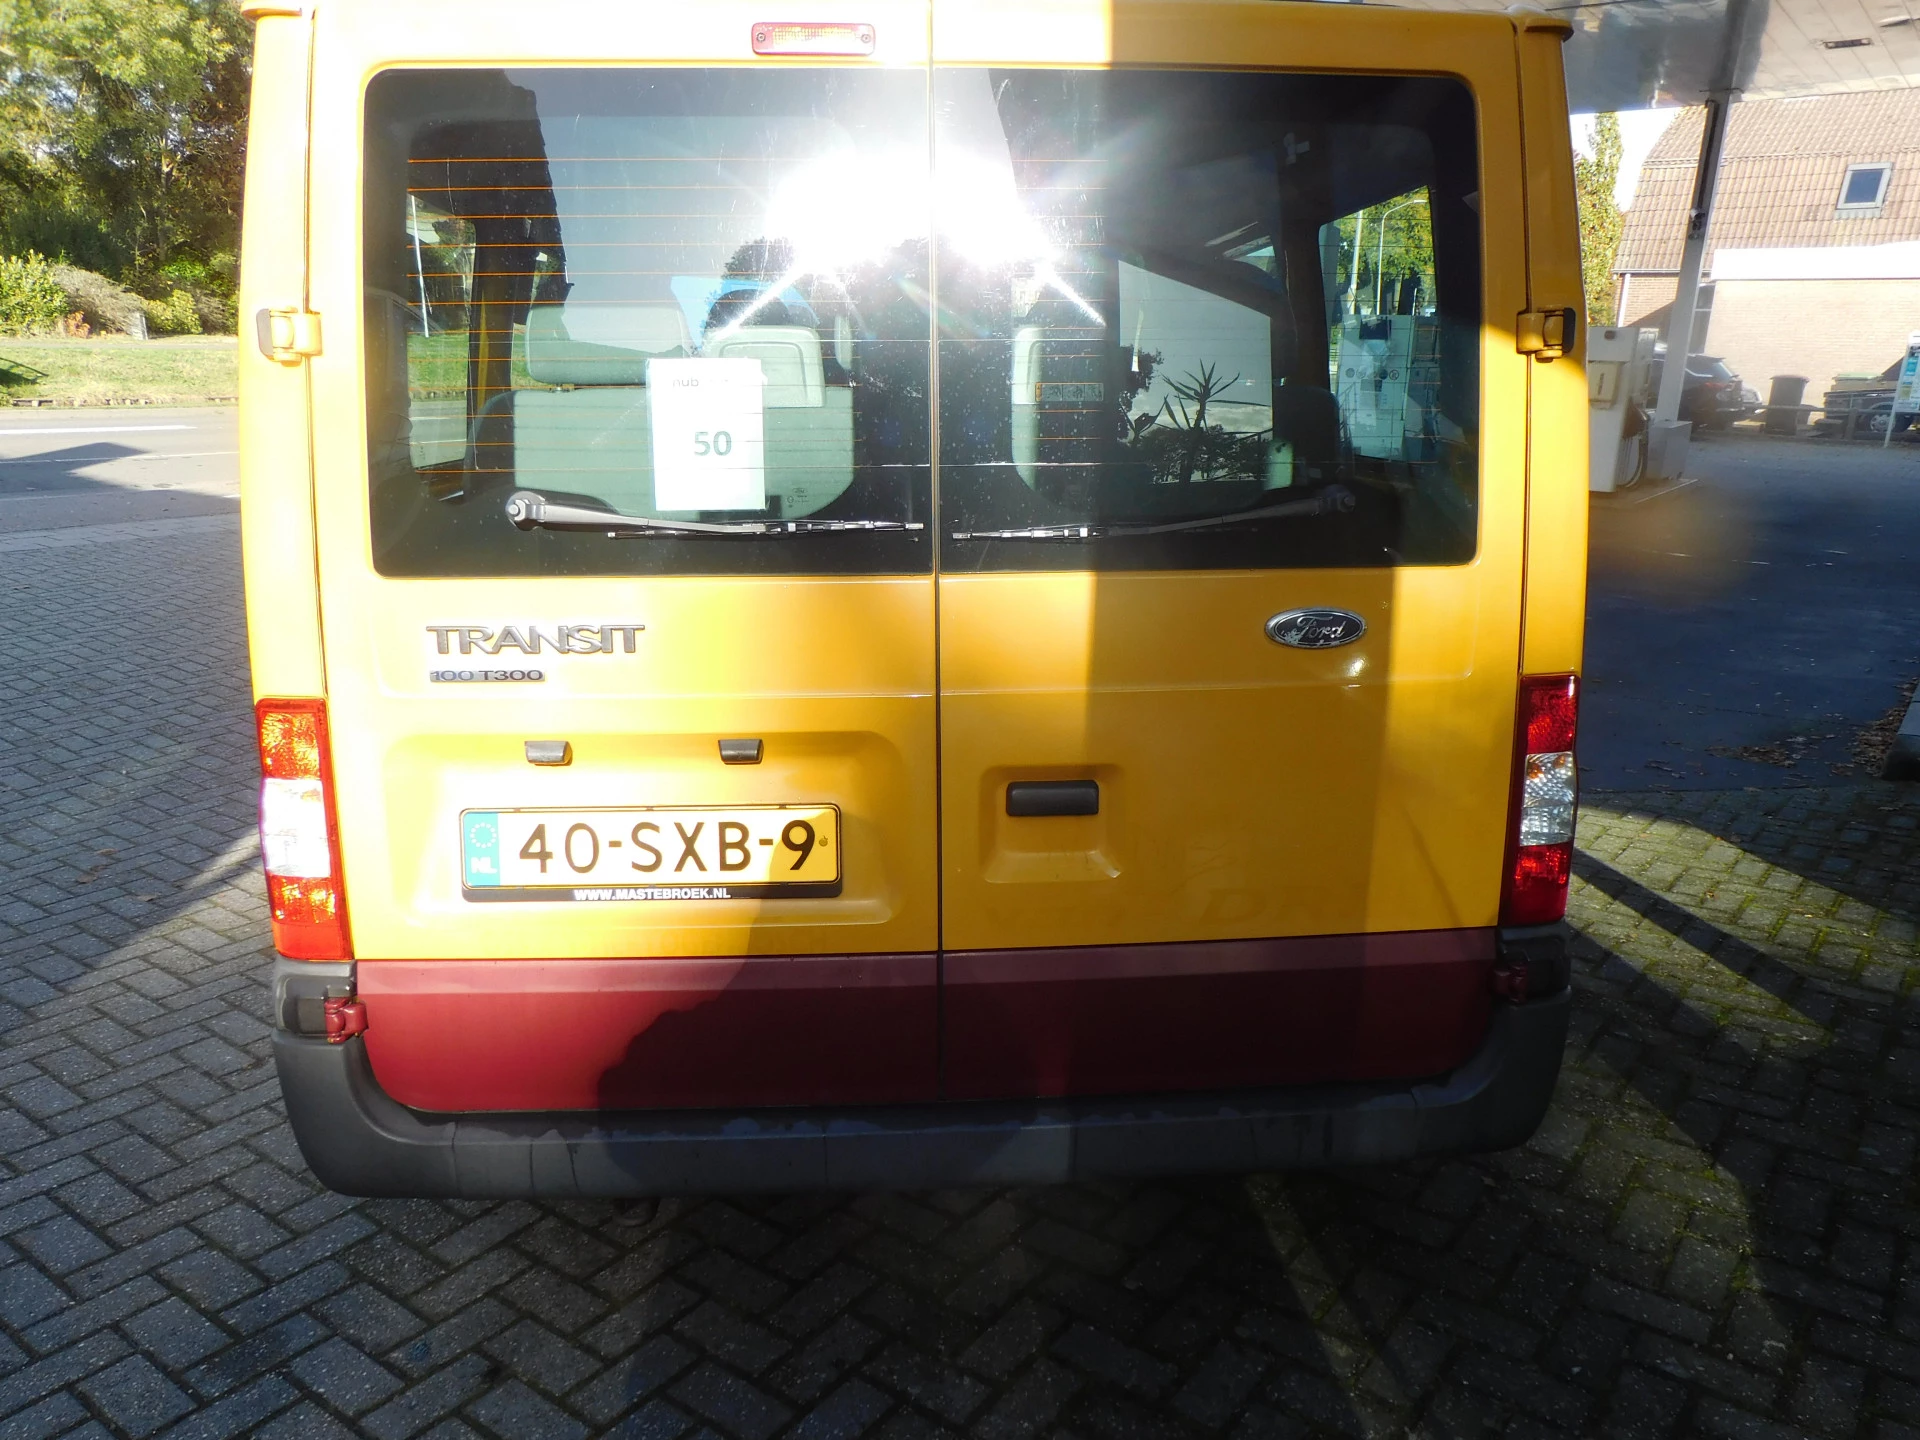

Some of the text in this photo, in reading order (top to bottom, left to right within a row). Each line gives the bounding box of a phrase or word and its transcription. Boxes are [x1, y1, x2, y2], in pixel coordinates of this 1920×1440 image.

[694, 430, 733, 457] 50
[425, 624, 646, 655] TRANSIT
[518, 820, 816, 874] 40-SXB-9
[470, 856, 498, 874] NL
[573, 887, 732, 901] WWW.MASTEBROEK.NL
